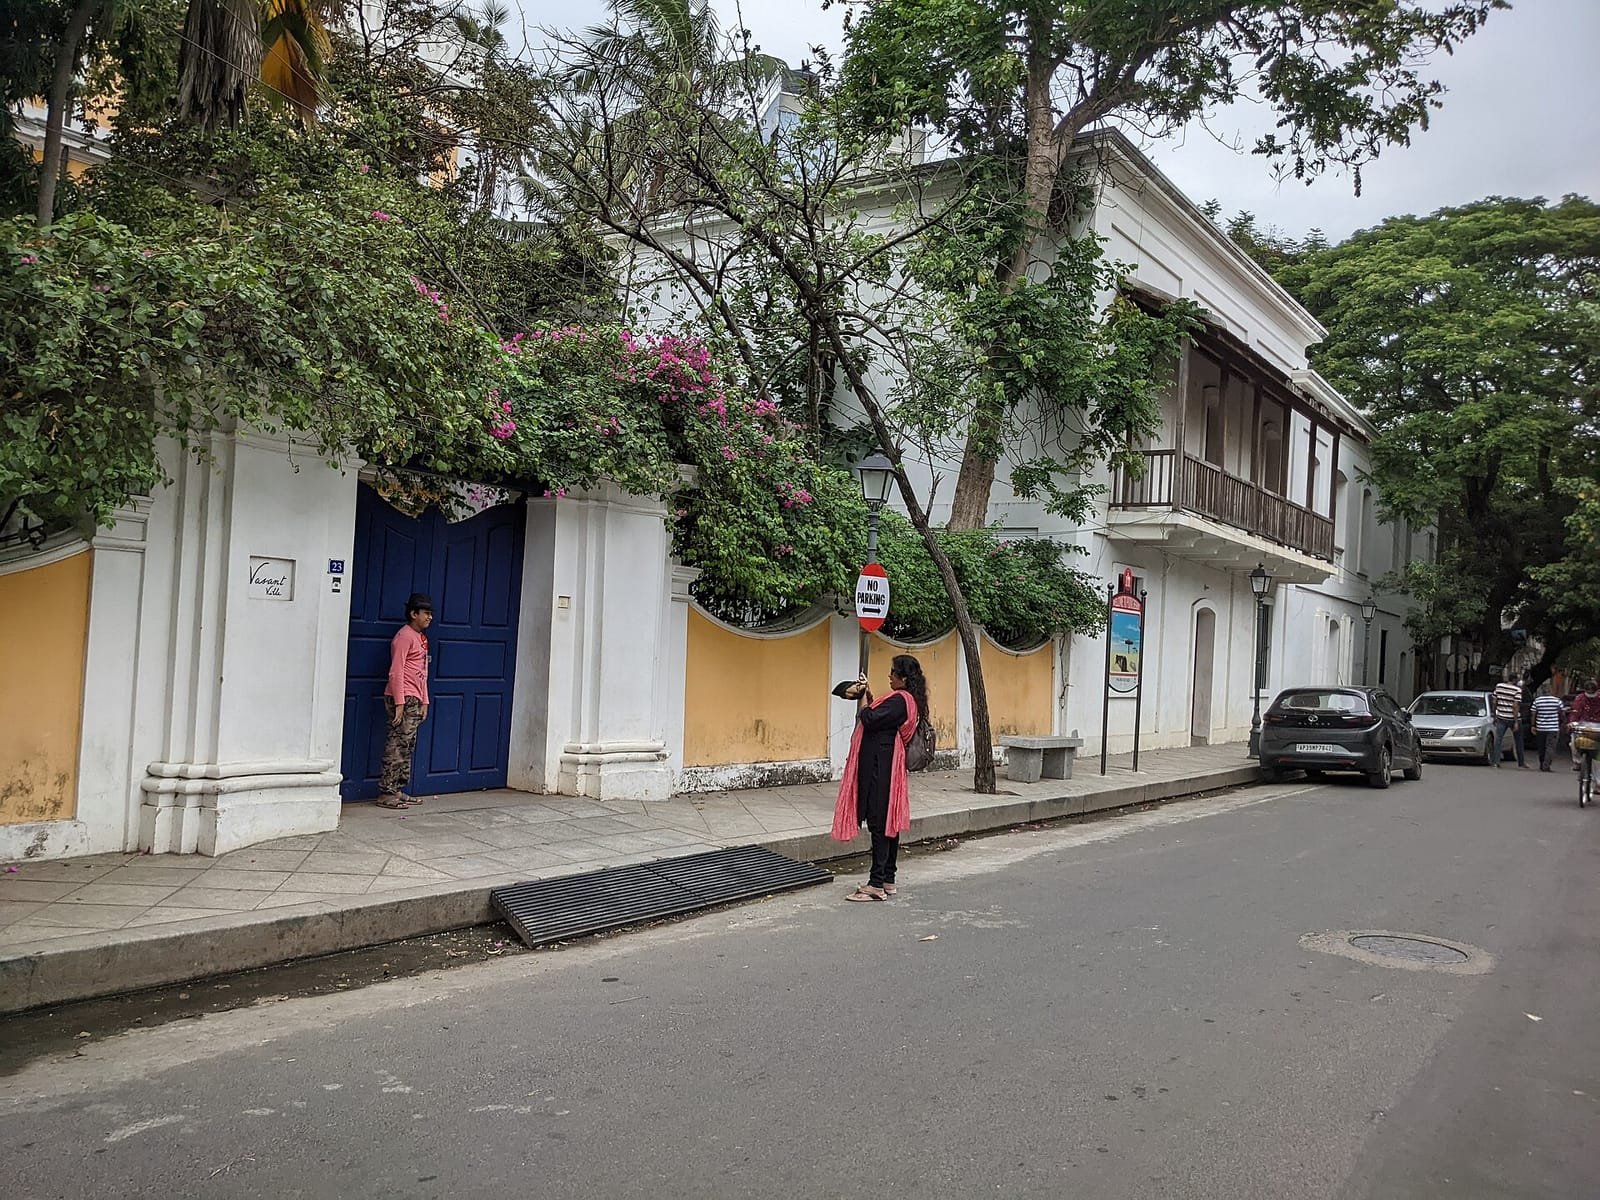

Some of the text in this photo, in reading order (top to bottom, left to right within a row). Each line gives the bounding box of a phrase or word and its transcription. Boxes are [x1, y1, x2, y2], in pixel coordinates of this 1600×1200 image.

[331, 562, 342, 572] 23
[249, 562, 287, 586] Vasant
[867, 580, 878, 592] NO
[857, 592, 886, 605] PARKING
